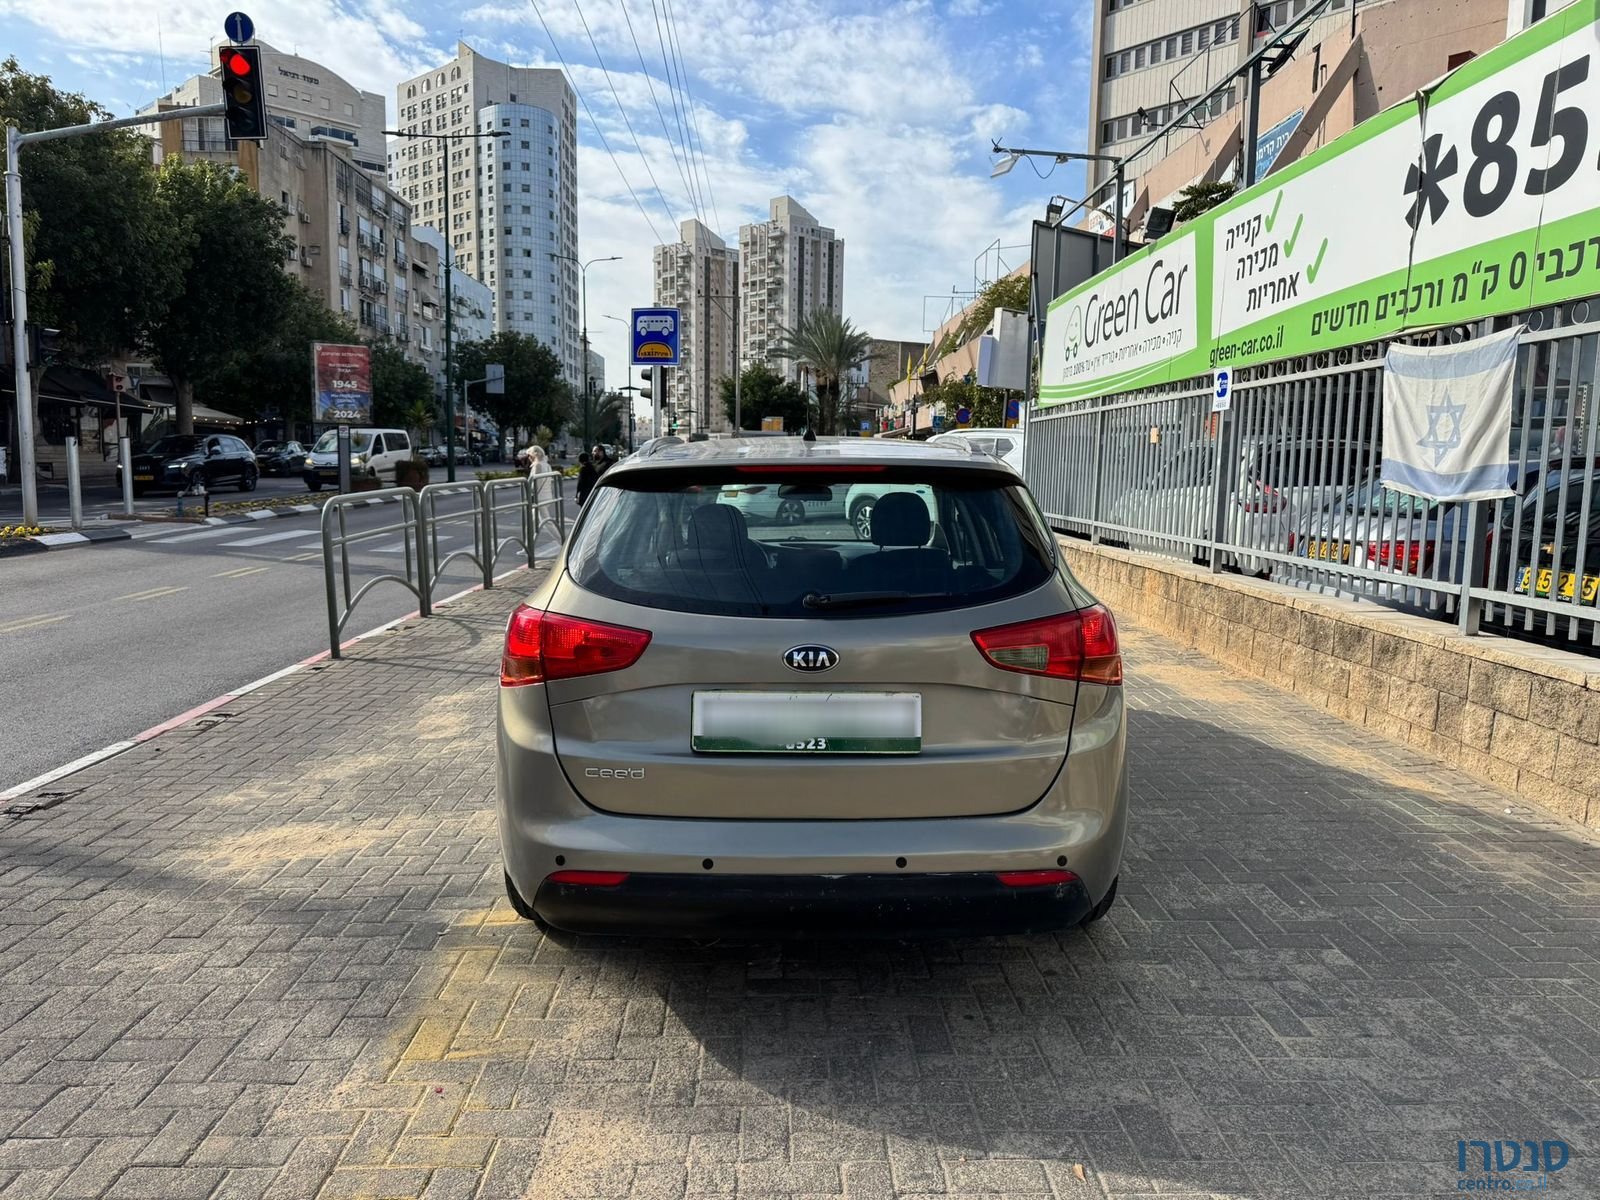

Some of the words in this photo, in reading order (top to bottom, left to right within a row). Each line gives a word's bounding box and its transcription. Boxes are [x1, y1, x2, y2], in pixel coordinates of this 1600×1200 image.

[1256, 140, 1275, 161] קדימ
[1403, 54, 1600, 231] 85
[1226, 214, 1262, 251] קנייה
[1236, 243, 1279, 281] מכירה
[1509, 251, 1527, 290] 0
[1084, 288, 1139, 348] Green
[1145, 259, 1188, 324] Car
[1246, 272, 1300, 312] אחריות
[1375, 278, 1443, 321] ורכבים
[1311, 300, 1369, 336] חדשים
[1210, 325, 1284, 368] green-car.co.il
[332, 380, 358, 389] 1945
[334, 410, 360, 419] 2024
[792, 651, 831, 667] KIA
